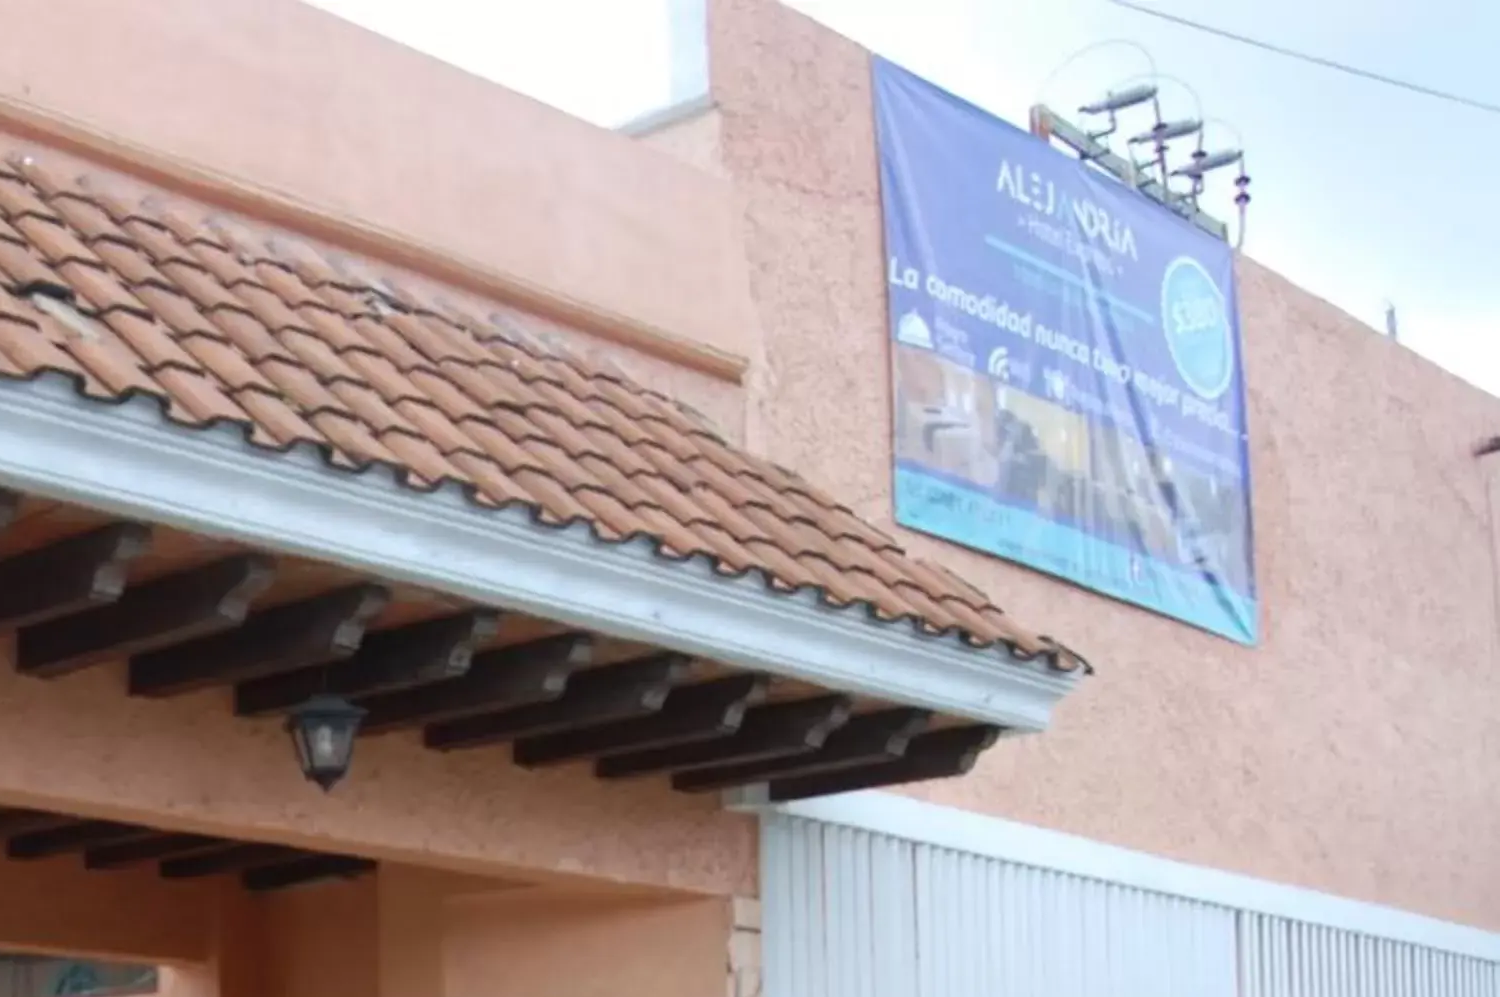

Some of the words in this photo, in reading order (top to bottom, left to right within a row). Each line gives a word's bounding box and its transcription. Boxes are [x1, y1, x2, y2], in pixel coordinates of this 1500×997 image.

[888, 256, 920, 290] La
[926, 272, 1032, 338] comodidad
[1035, 325, 1090, 366] nunca
